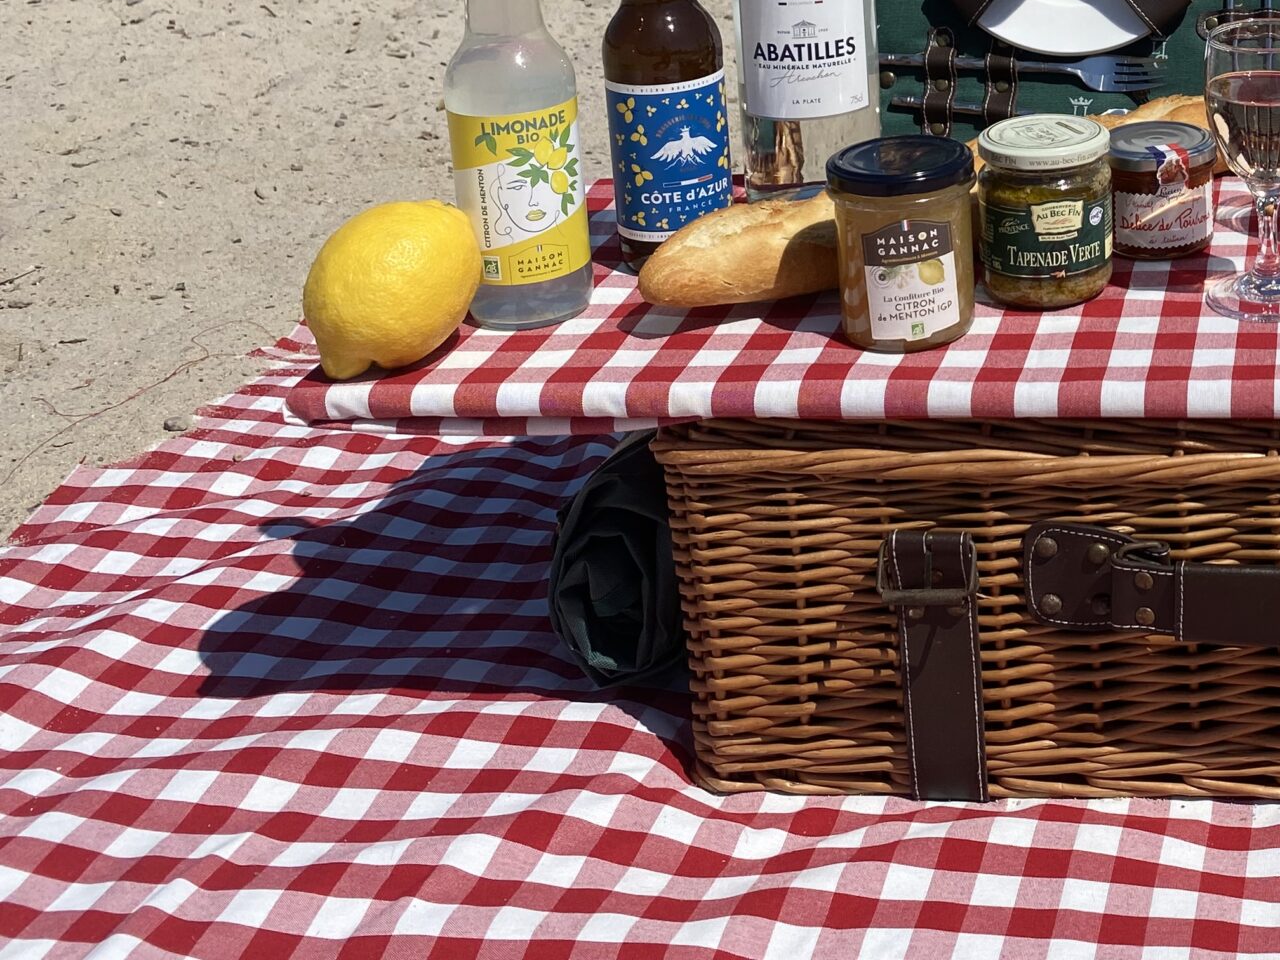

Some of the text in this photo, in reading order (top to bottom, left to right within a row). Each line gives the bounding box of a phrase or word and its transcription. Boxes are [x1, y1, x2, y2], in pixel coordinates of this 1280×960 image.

[753, 36, 856, 62] ABATILLES
[812, 59, 852, 69] NATURELLE
[481, 109, 566, 136] LIMONADE
[516, 132, 540, 145] BIO
[641, 177, 729, 205] CÔTE d'AZUR
[477, 169, 491, 248] CITRON DE MENTON
[669, 200, 713, 213] FRANCE
[998, 222, 1030, 233] PROVENCE
[1158, 216, 1173, 231] de
[877, 228, 938, 246] MAISON
[878, 240, 939, 256] GANNAC
[1007, 245, 1068, 267] TAPENADE
[1069, 240, 1101, 263] VERTE
[518, 252, 563, 266] MAISON
[518, 259, 563, 273] GANNAC
[883, 287, 945, 303] La Confiture Bio
[878, 300, 953, 322] de MENTON IGP
[895, 297, 935, 312] CITRON
